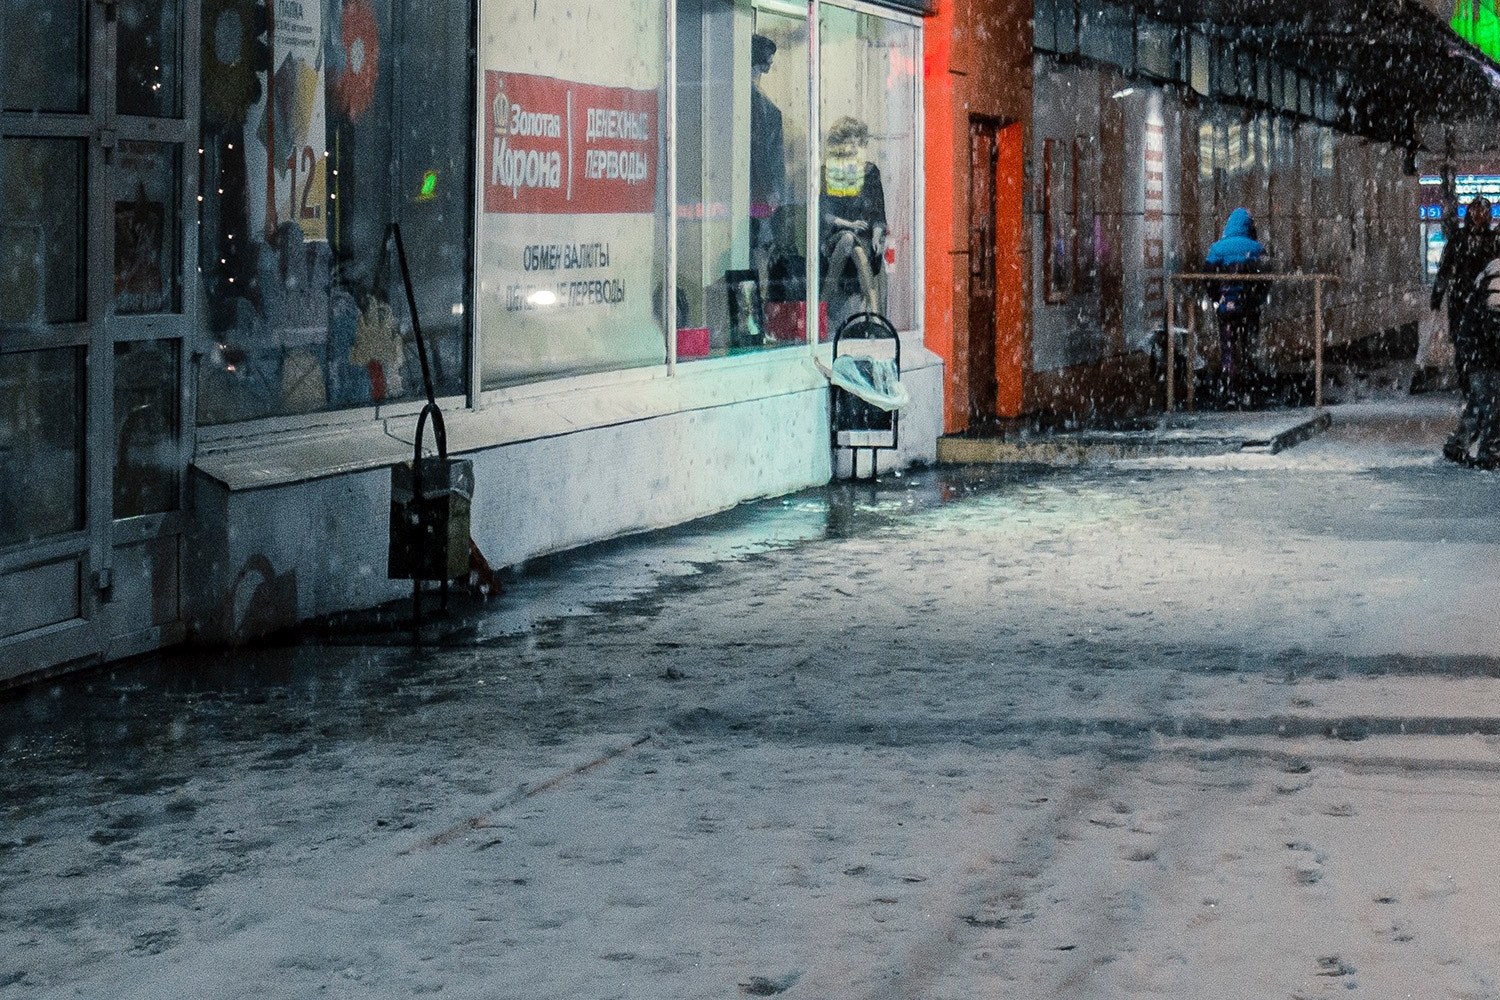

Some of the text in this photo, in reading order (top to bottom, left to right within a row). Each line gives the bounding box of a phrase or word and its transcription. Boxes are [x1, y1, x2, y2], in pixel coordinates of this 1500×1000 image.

[509, 103, 561, 138] Золотая
[586, 108, 649, 143] ДЕНЕЖНЫЕ
[491, 136, 562, 200] Корона
[585, 149, 648, 185] ПЕРЕВОДЫ
[523, 242, 610, 272] ОБМЕН ВАЛЮТЫ
